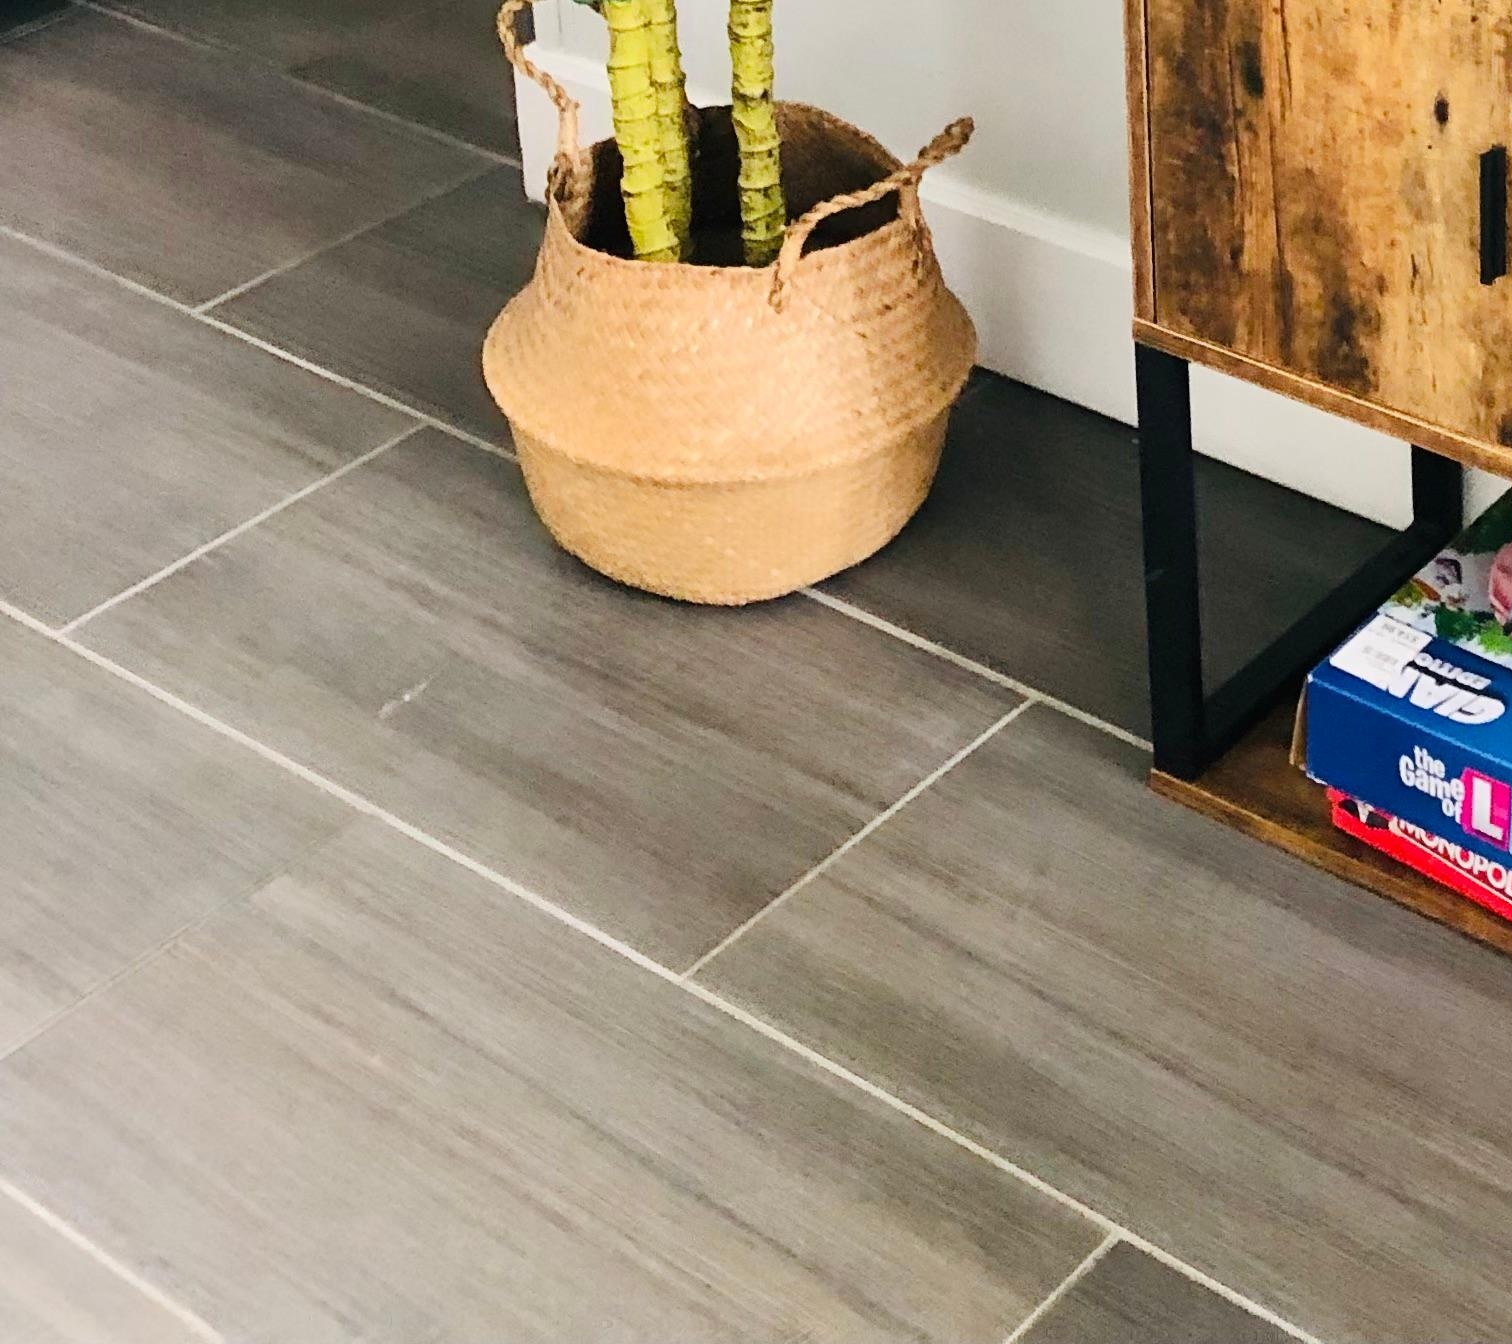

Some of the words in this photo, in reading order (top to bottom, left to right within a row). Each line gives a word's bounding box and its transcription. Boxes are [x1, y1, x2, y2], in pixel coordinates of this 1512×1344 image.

[1413, 651, 1493, 691] EDITIO
[1386, 665, 1507, 725] GIAN
[1398, 754, 1467, 802] Game
[1413, 744, 1446, 780] the
[1440, 797, 1464, 825] of
